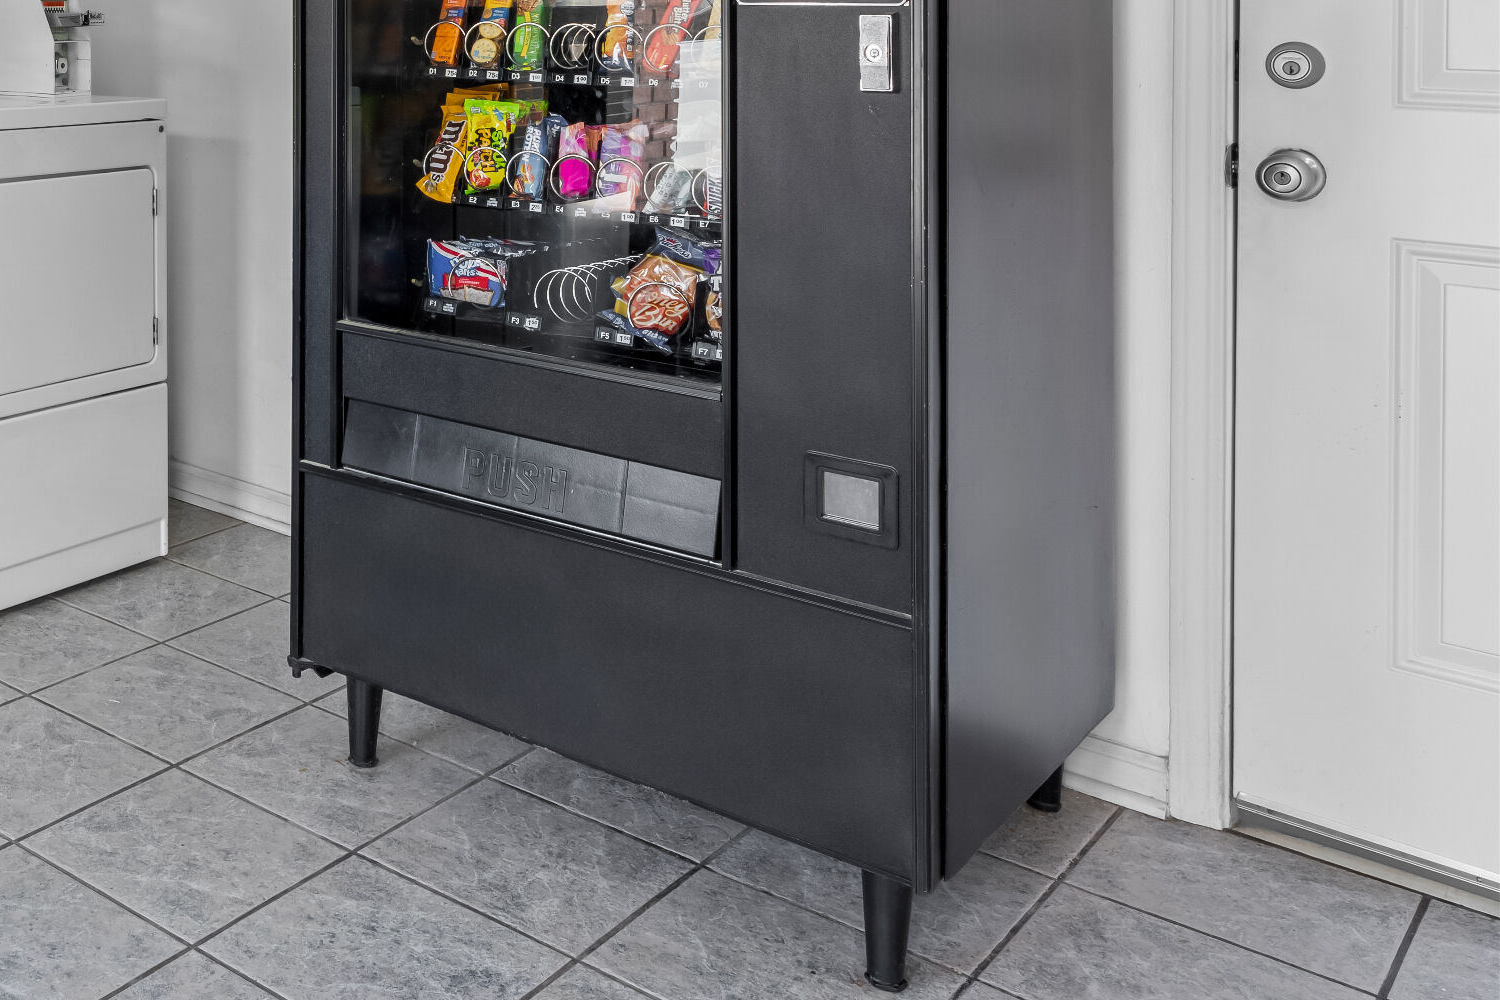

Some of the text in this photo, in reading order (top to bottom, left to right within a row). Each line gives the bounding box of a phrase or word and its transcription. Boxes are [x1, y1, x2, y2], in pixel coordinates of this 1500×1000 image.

[672, 6, 683, 33] Buttr
[477, 128, 497, 172] PATCH
[531, 129, 542, 154] PUR
[461, 446, 568, 513] PUSH
